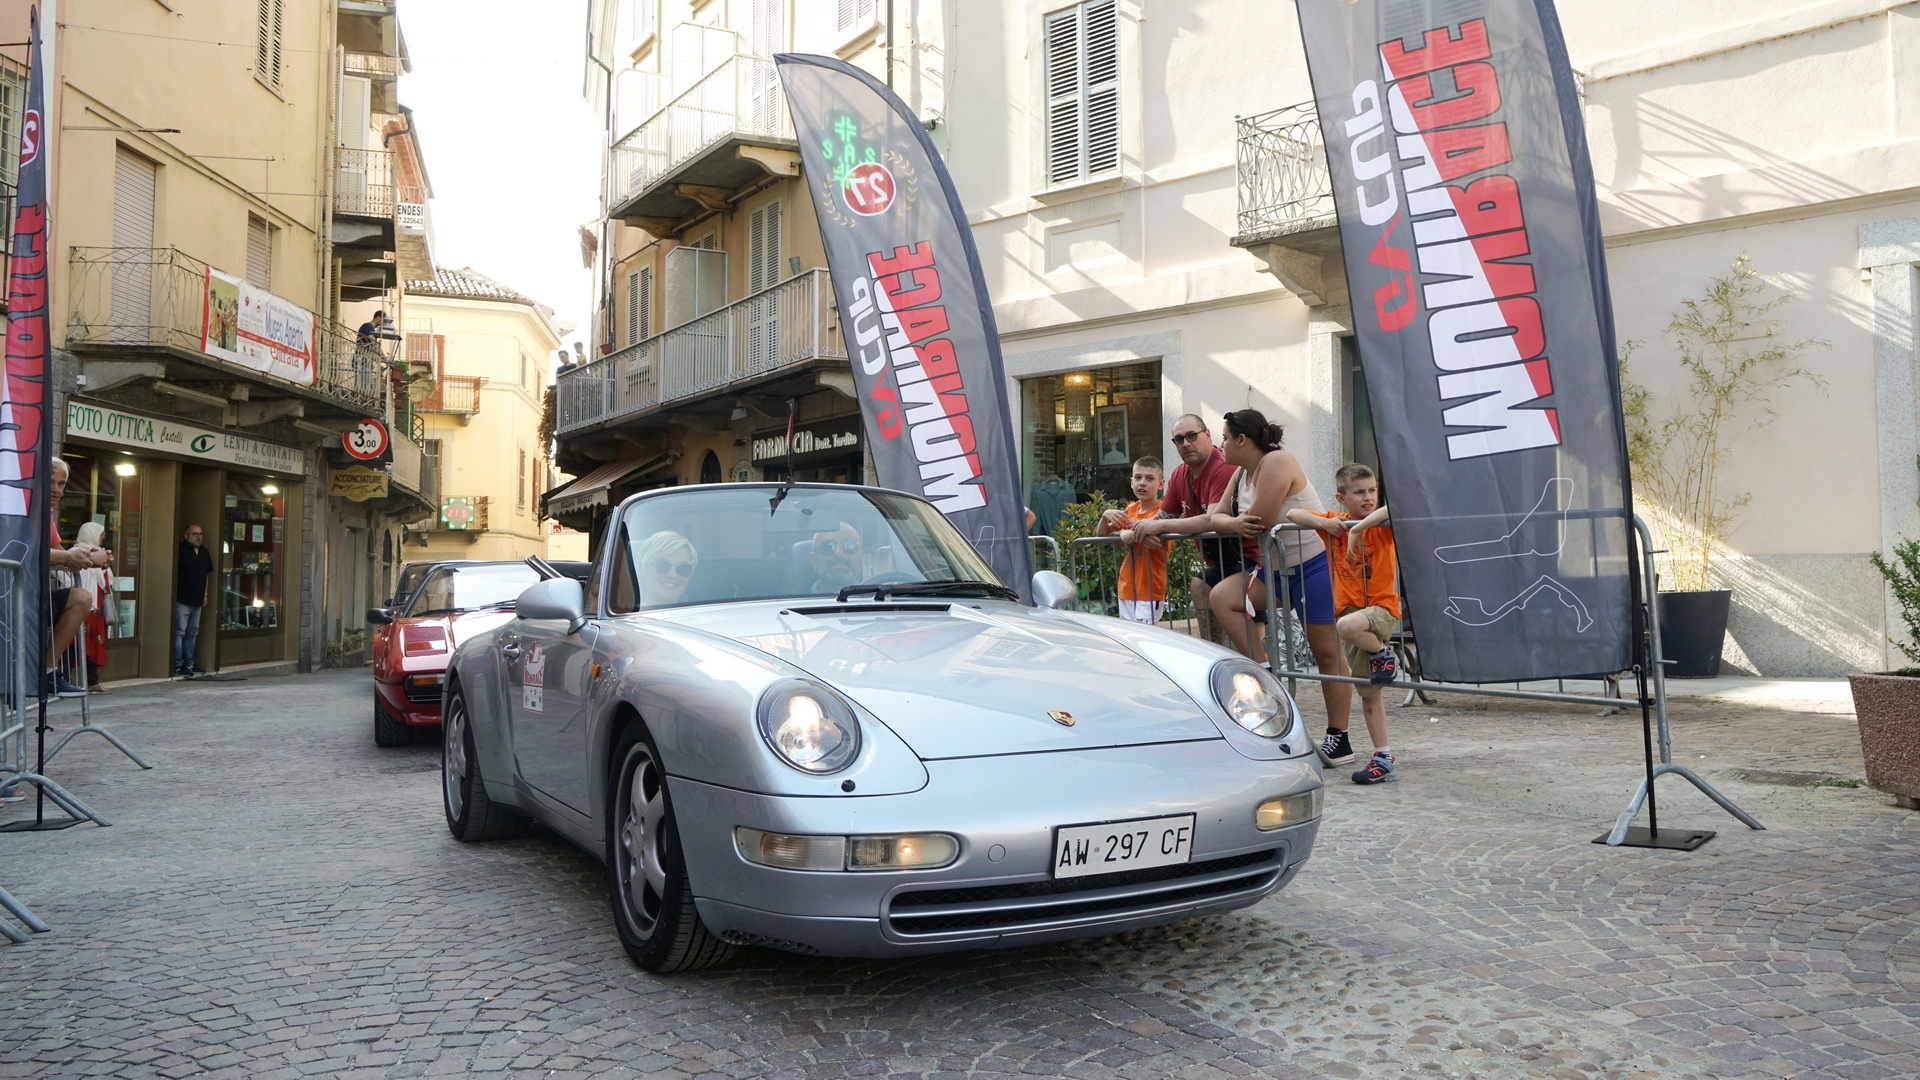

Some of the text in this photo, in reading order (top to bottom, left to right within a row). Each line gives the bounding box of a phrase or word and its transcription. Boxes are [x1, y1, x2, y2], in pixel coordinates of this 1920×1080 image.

[397, 204, 424, 217] ENDESI
[398, 216, 424, 225] 7.220643
[265, 310, 284, 342] Museo
[284, 318, 304, 350] Aperto
[270, 347, 300, 368] entrata
[67, 404, 184, 444] FOTO OTTICA Castelli
[223, 435, 302, 462] LENTI A CONTATTO
[752, 430, 858, 461] FARMCIA Dott. Tardito
[333, 474, 383, 484] ACCONCIATURE
[1058, 826, 1190, 868] AW 297 CF
